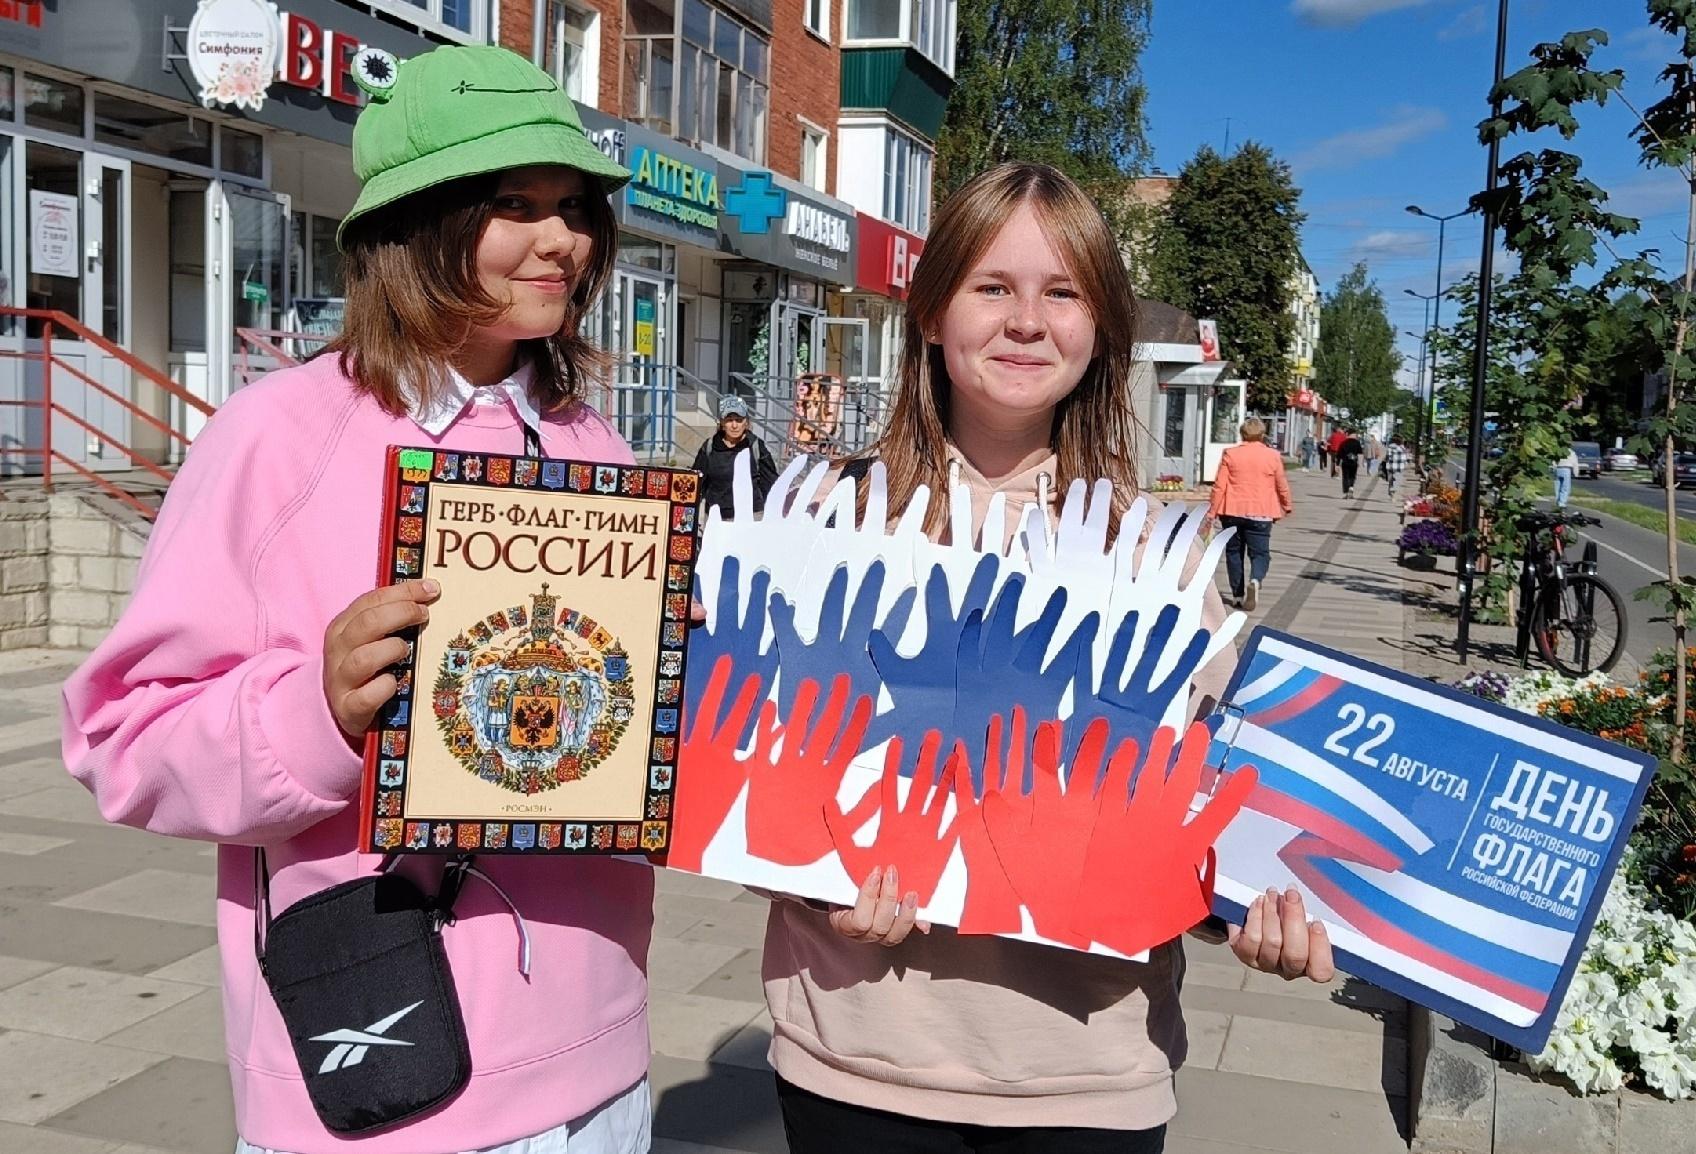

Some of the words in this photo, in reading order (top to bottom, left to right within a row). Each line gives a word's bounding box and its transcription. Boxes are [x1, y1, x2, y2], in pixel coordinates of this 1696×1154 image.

[199, 42, 263, 56] Симфония
[633, 146, 719, 209] АПТЕКА
[439, 499, 496, 524] ГЕРБ
[506, 503, 575, 529] ФЛАГ
[584, 510, 659, 535] ГИМН
[433, 528, 657, 581] РОССИИ
[1323, 702, 1396, 769] 22
[1382, 752, 1469, 802] АВГУСТА
[1490, 759, 1615, 843] ДЕНЬ
[1483, 812, 1600, 867] ГОСУДАРСТВЕННОГО
[1461, 866, 1520, 900] РОССИЙСКОЙ
[1519, 888, 1578, 921] ФЕДЕРАЦИИ
[1472, 832, 1588, 906] ФЛАГА
